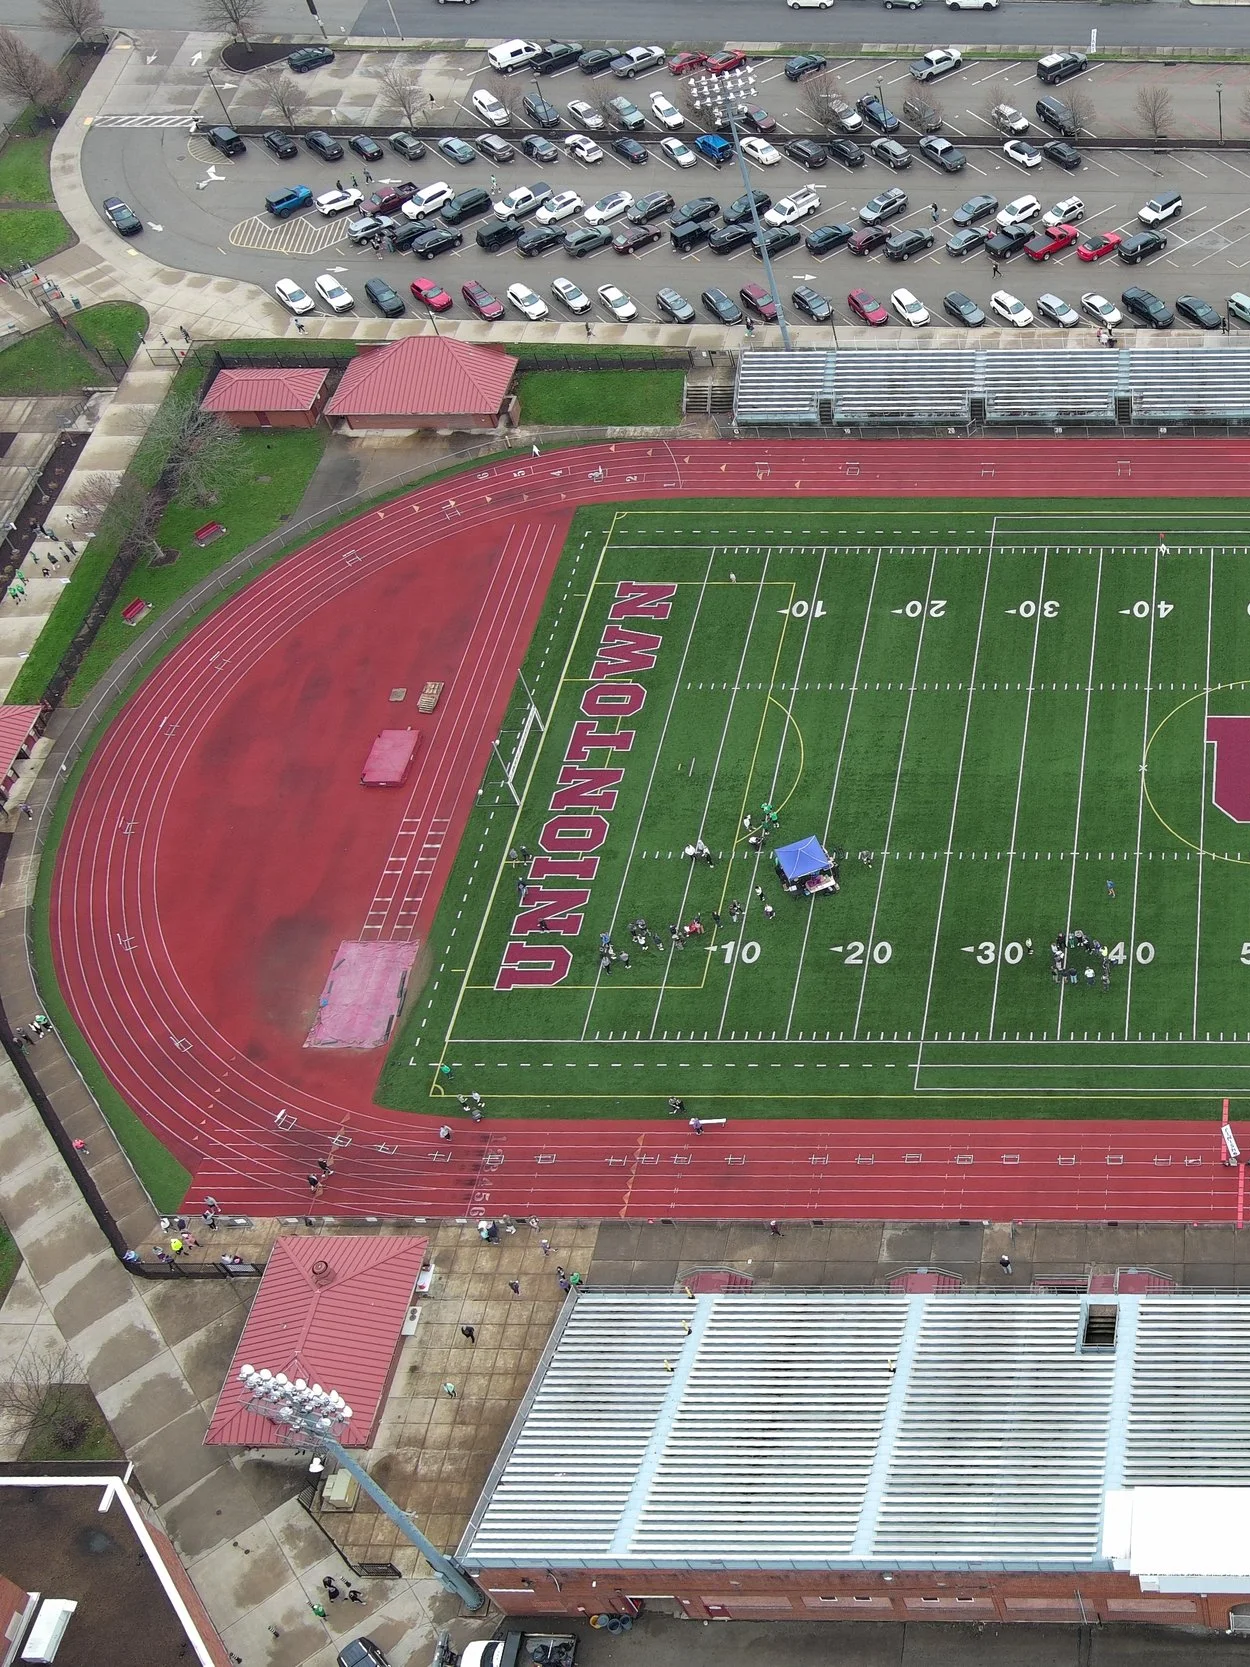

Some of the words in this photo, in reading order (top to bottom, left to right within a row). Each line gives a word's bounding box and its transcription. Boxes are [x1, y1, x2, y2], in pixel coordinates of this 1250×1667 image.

[784, 599, 827, 618] 10
[905, 599, 947, 618] 20
[1018, 599, 1060, 618] 30
[1132, 599, 1175, 618] 40
[494, 581, 677, 991] UNIONTOWN
[721, 940, 761, 965] 10
[844, 940, 892, 965] 20
[975, 940, 1024, 965] 30
[1108, 940, 1155, 965] 40
